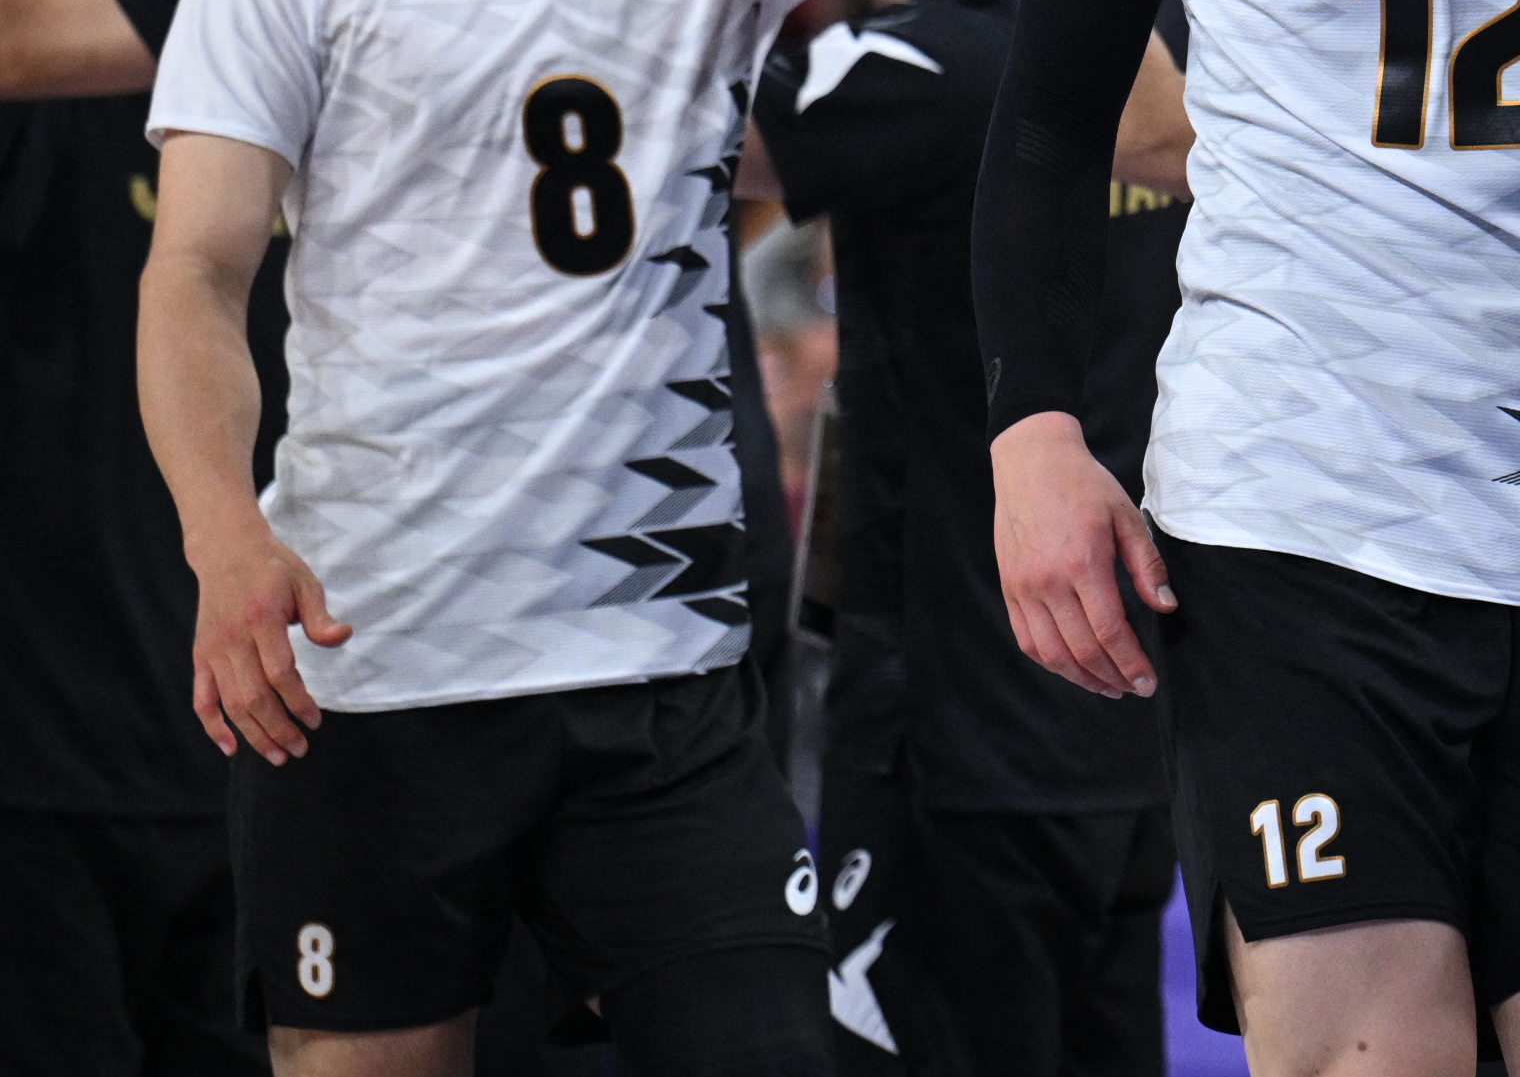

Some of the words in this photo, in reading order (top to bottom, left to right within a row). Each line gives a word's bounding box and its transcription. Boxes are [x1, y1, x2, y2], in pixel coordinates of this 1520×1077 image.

[522, 73, 636, 278] 8
[1250, 792, 1347, 890] 12
[297, 921, 337, 999] 8
